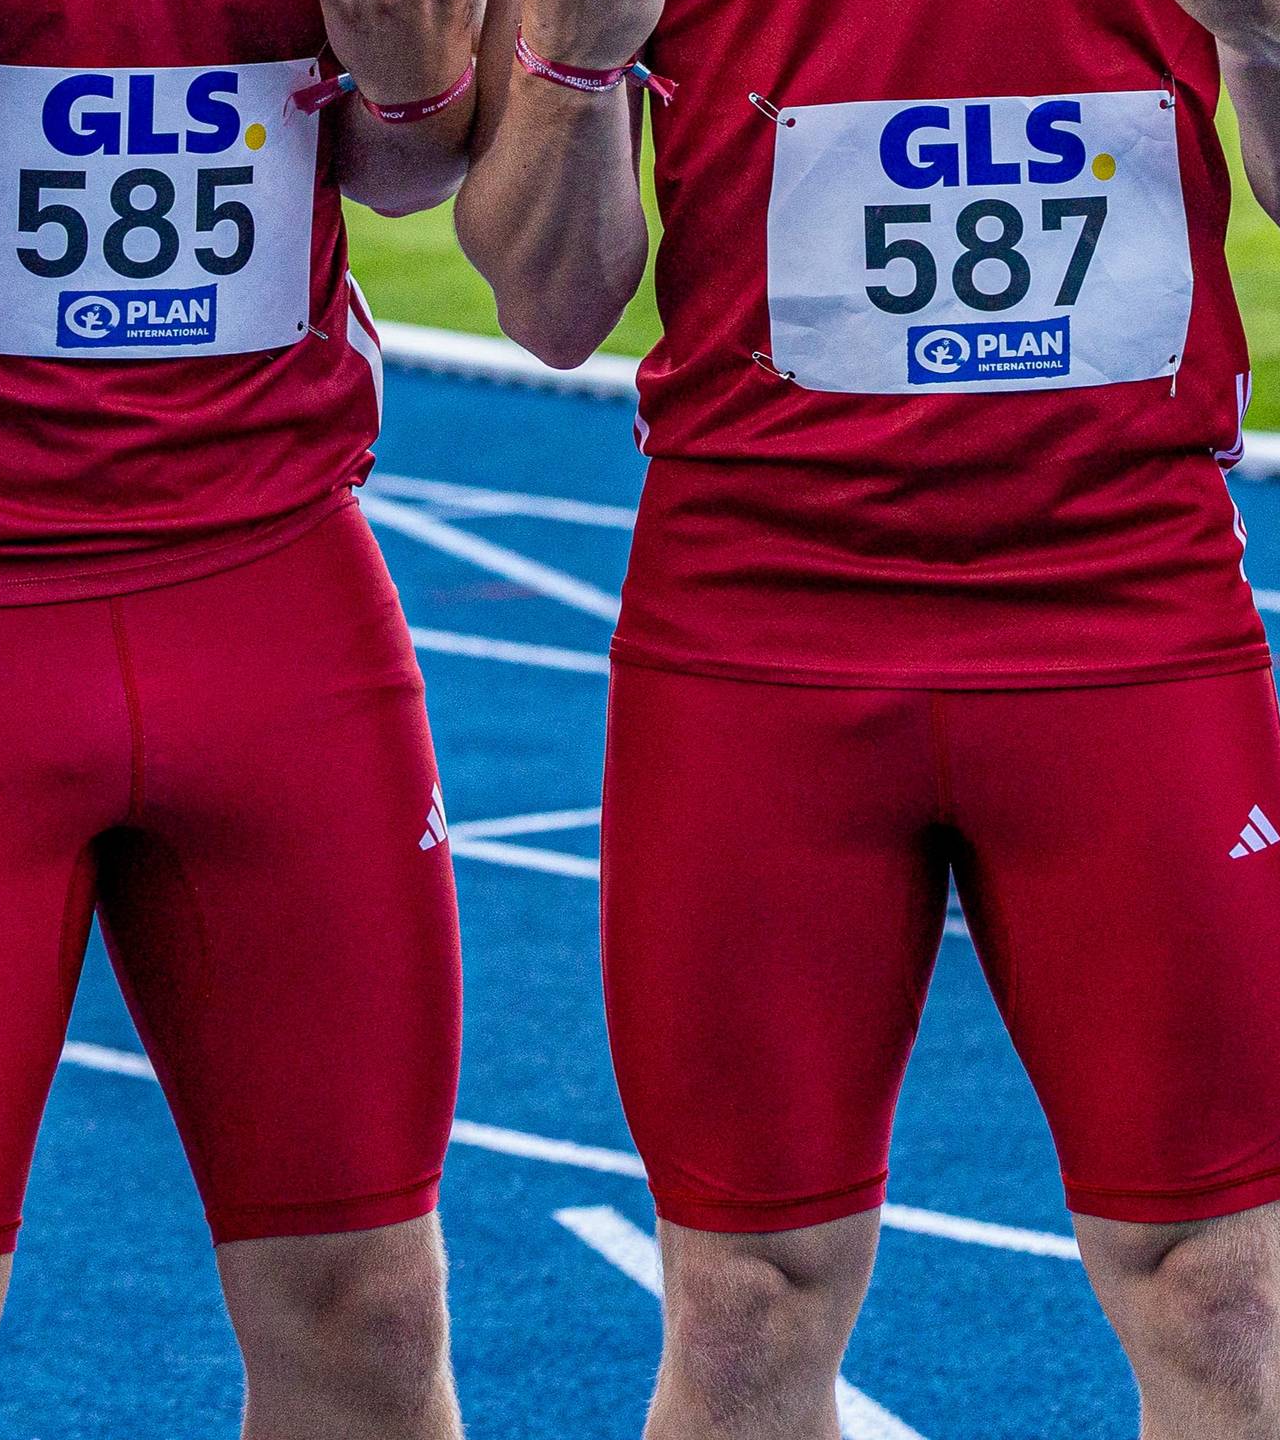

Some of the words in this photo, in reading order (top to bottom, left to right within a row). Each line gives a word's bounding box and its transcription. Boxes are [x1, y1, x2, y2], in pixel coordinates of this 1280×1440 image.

[16, 165, 256, 279] 585
[864, 195, 1108, 315] 587
[127, 298, 210, 325] PLAN
[126, 328, 209, 338] INTERNATIONAL
[977, 330, 1063, 359] PLAN
[978, 359, 1063, 372] INTERNATIONAL
